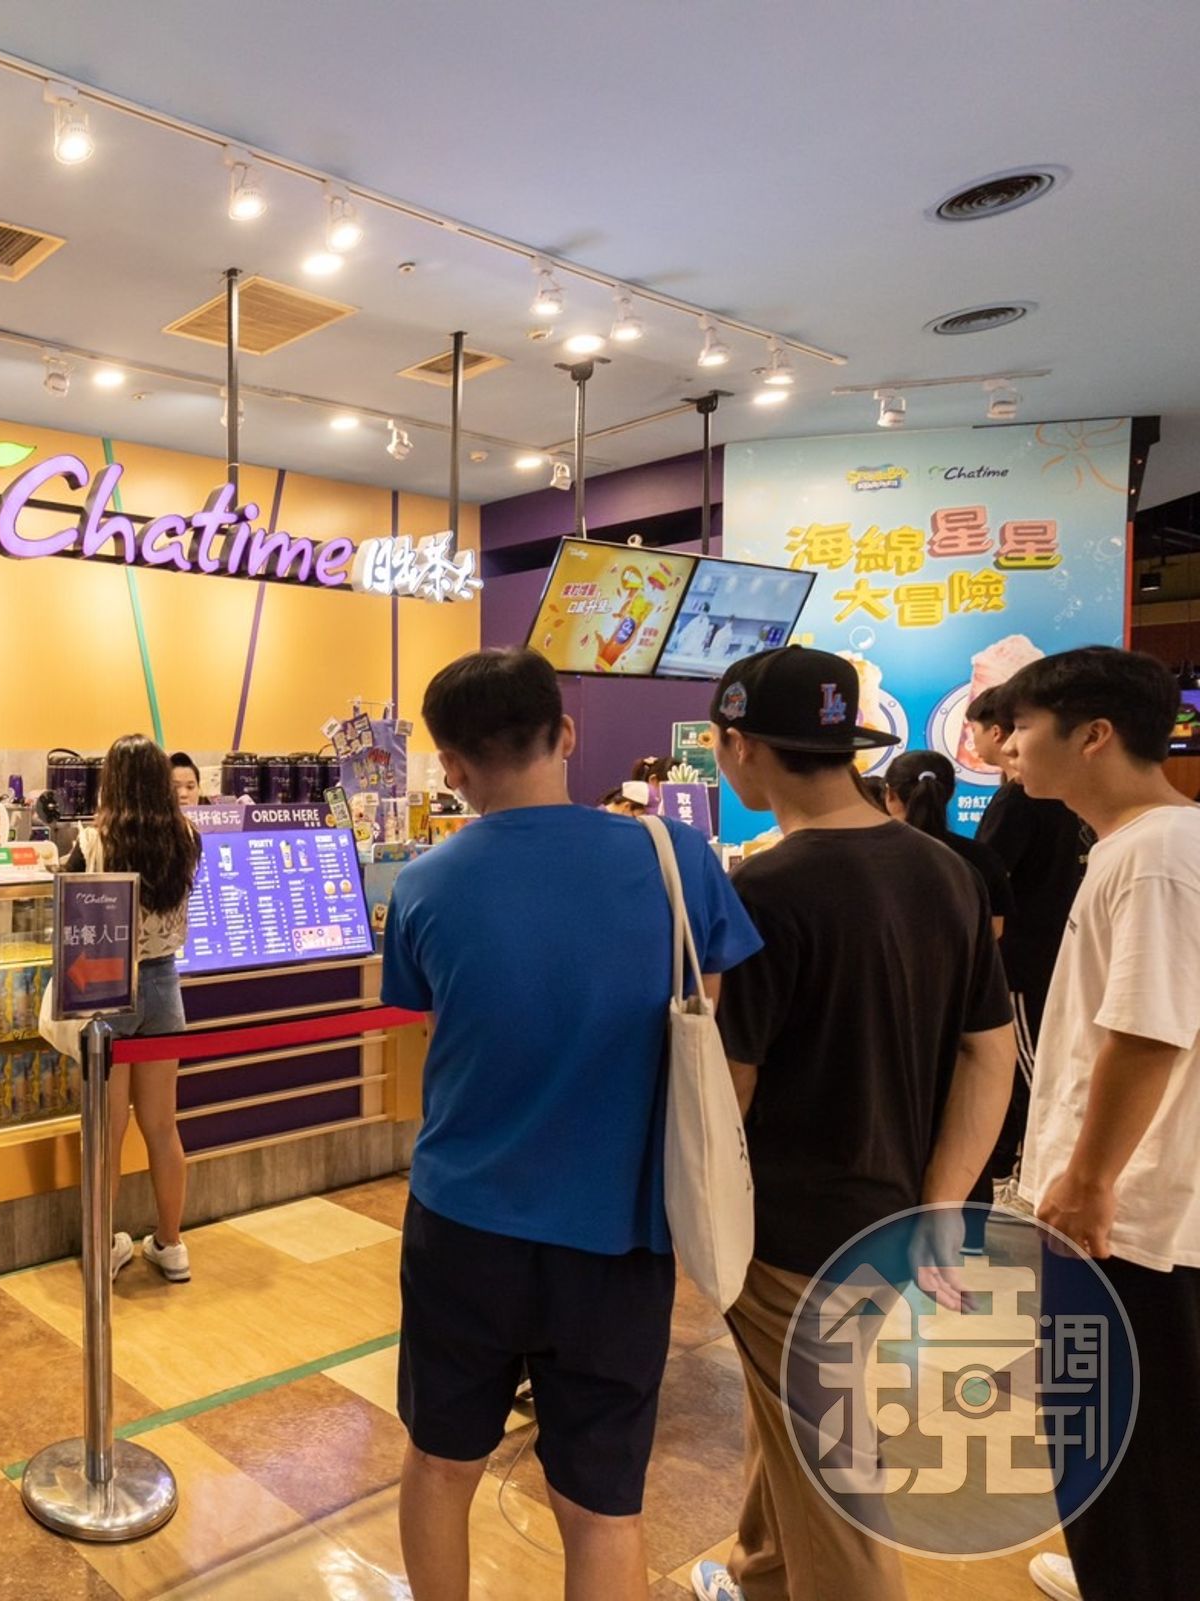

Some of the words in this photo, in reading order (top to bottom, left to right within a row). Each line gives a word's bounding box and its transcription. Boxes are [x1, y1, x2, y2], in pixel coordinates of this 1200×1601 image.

[944, 466, 1009, 480] Chatime
[784, 504, 1063, 576] 海綿星星
[358, 531, 485, 603] 日出茶太
[833, 568, 1009, 628] 大冒險
[820, 683, 847, 725] LA
[252, 809, 291, 823] ORDER
[292, 808, 320, 821] HERE
[63, 924, 129, 946] 點餐入口
